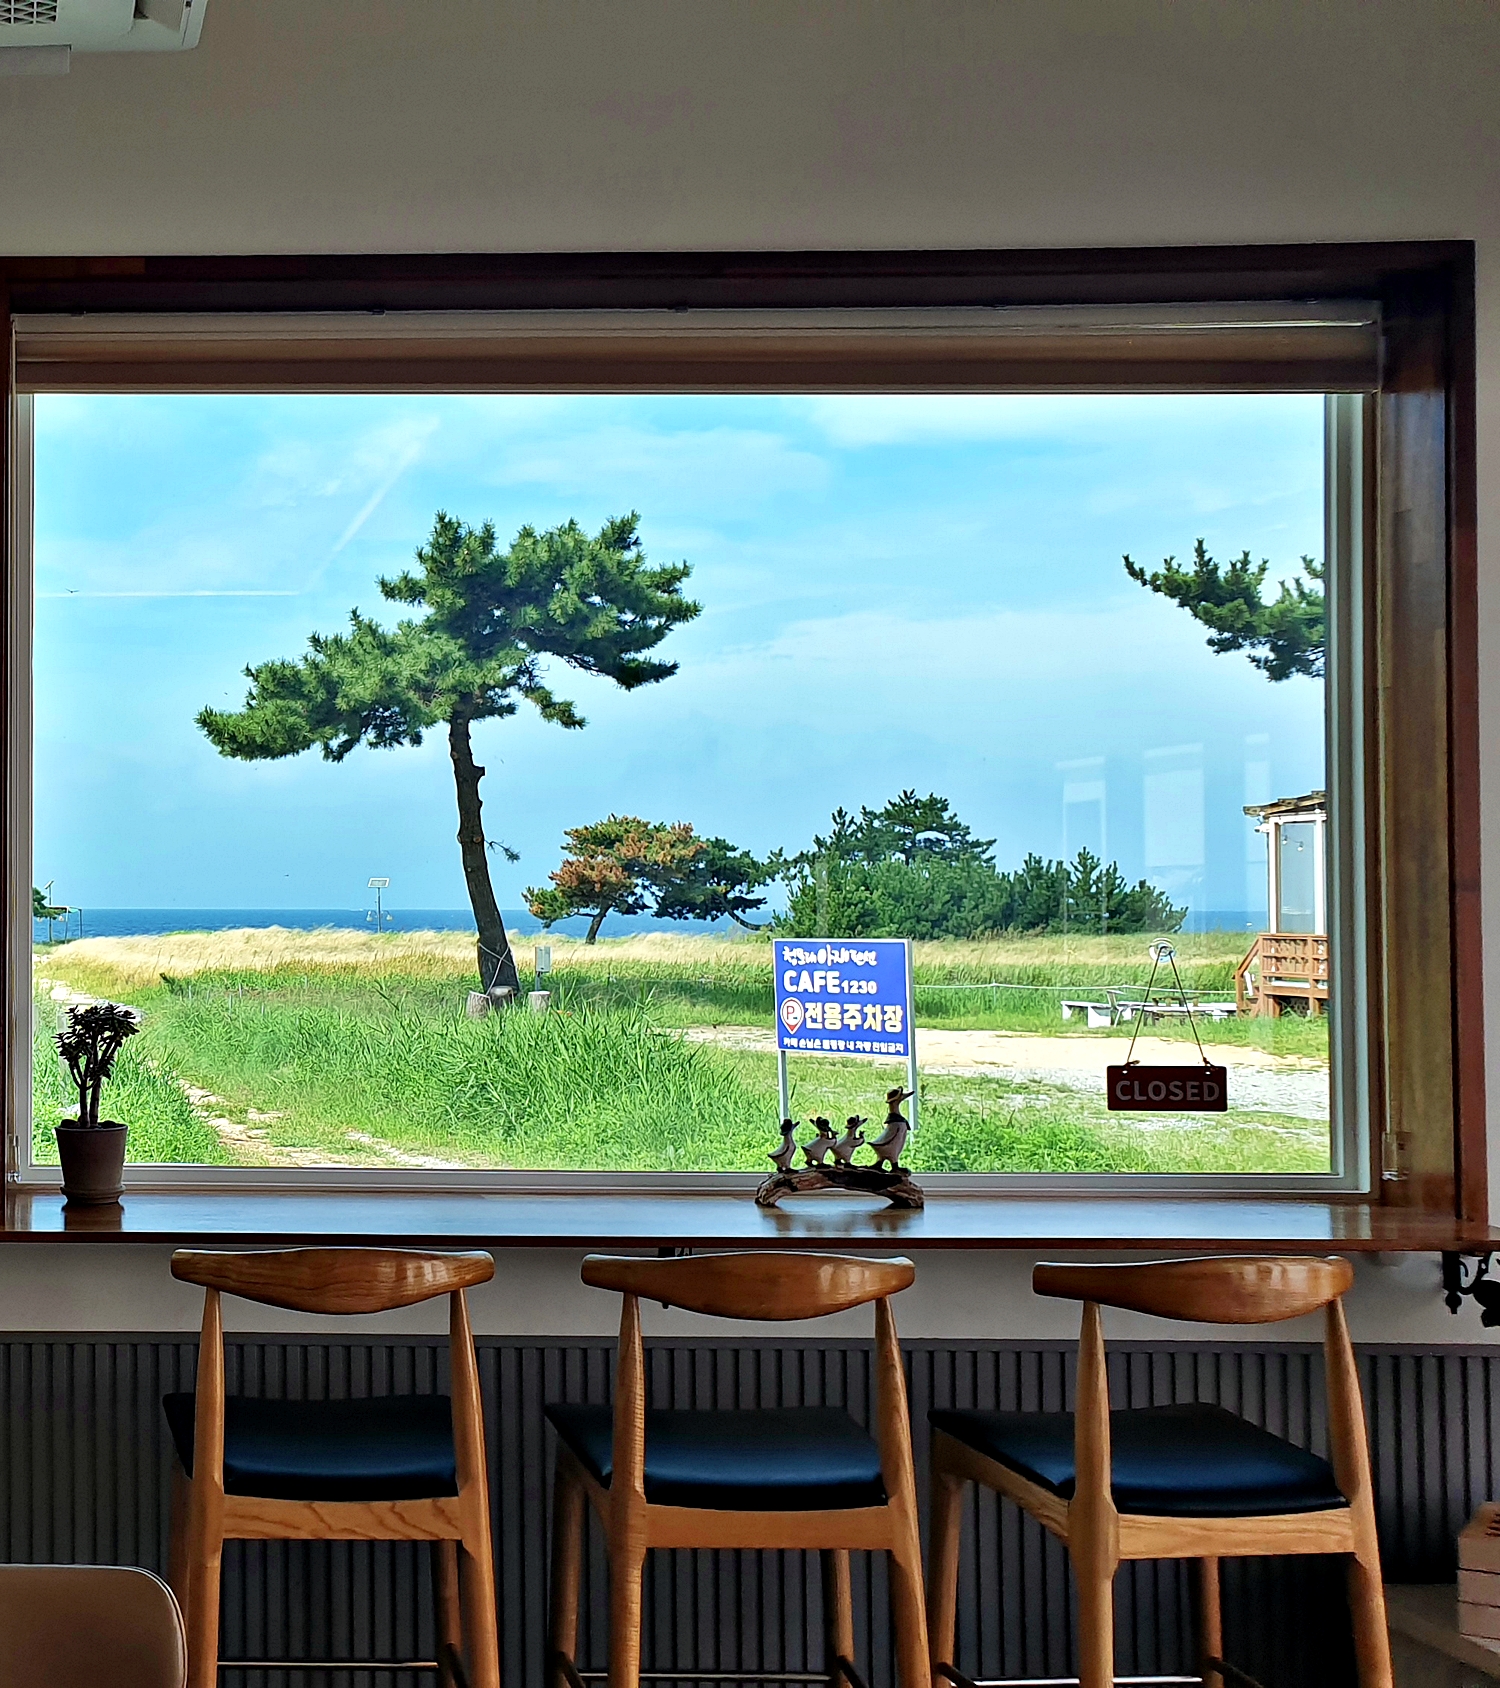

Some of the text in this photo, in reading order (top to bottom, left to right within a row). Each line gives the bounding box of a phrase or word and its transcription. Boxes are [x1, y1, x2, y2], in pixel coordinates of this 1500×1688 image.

[784, 970, 877, 994] CAFE 1230
[804, 1002, 903, 1033] 전용주차장
[783, 1036, 798, 1048] 카페
[1115, 1080, 1219, 1101] CLOSED
